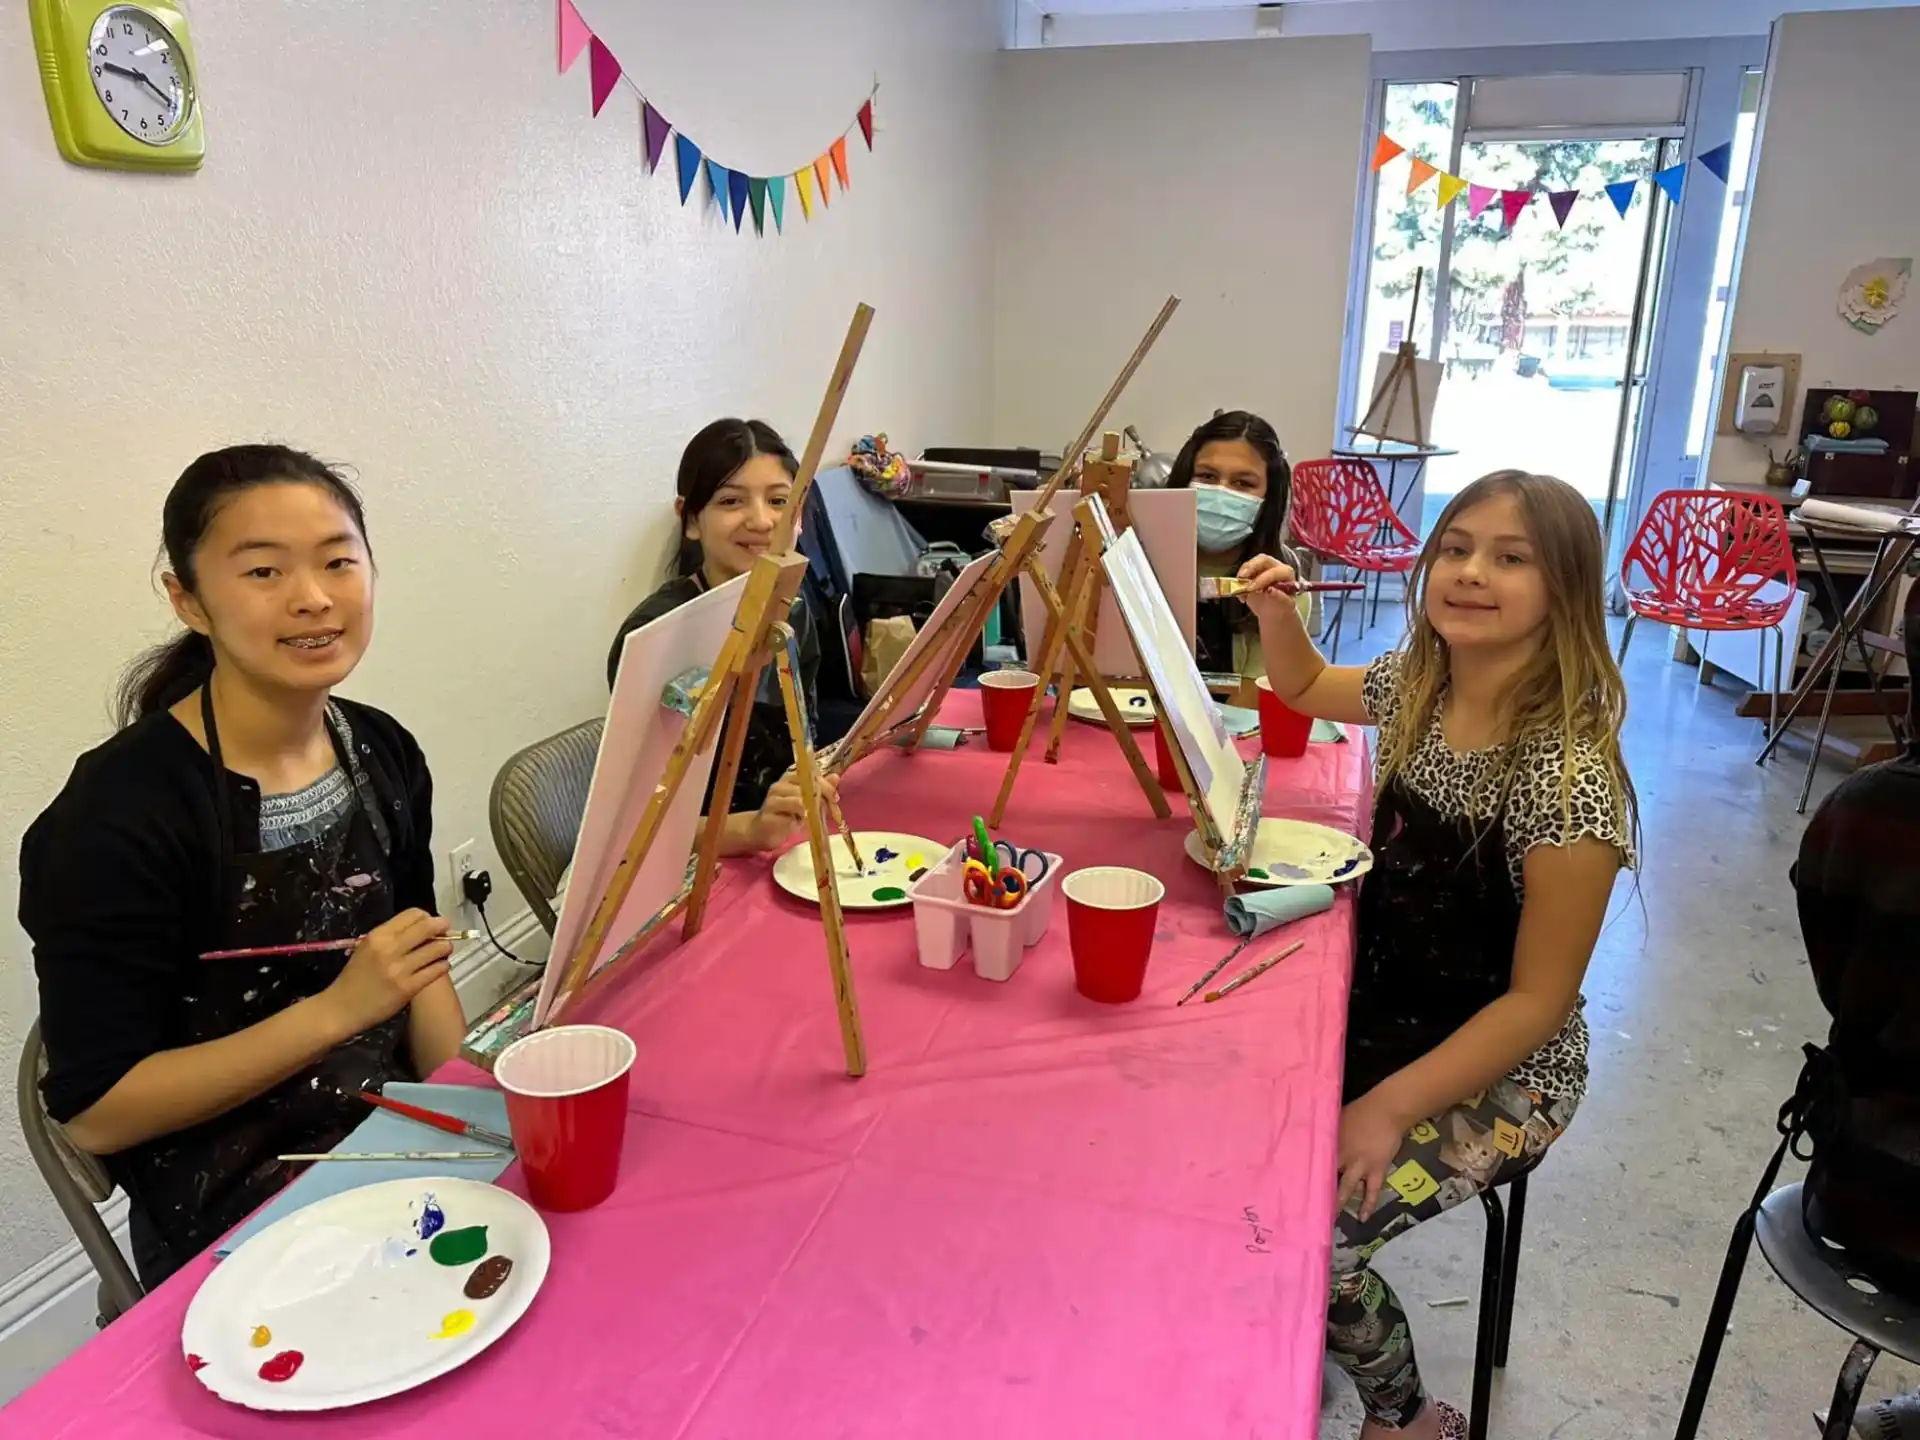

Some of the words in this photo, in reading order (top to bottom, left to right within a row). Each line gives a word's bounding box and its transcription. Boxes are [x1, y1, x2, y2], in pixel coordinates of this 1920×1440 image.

[106, 27, 115, 39] 11
[123, 23, 134, 36] 12
[96, 44, 108, 56] 10
[94, 65, 102, 78] 9
[105, 90, 113, 103] 8
[121, 109, 129, 121] 7
[157, 114, 165, 126] 5
[140, 118, 148, 130] 6
